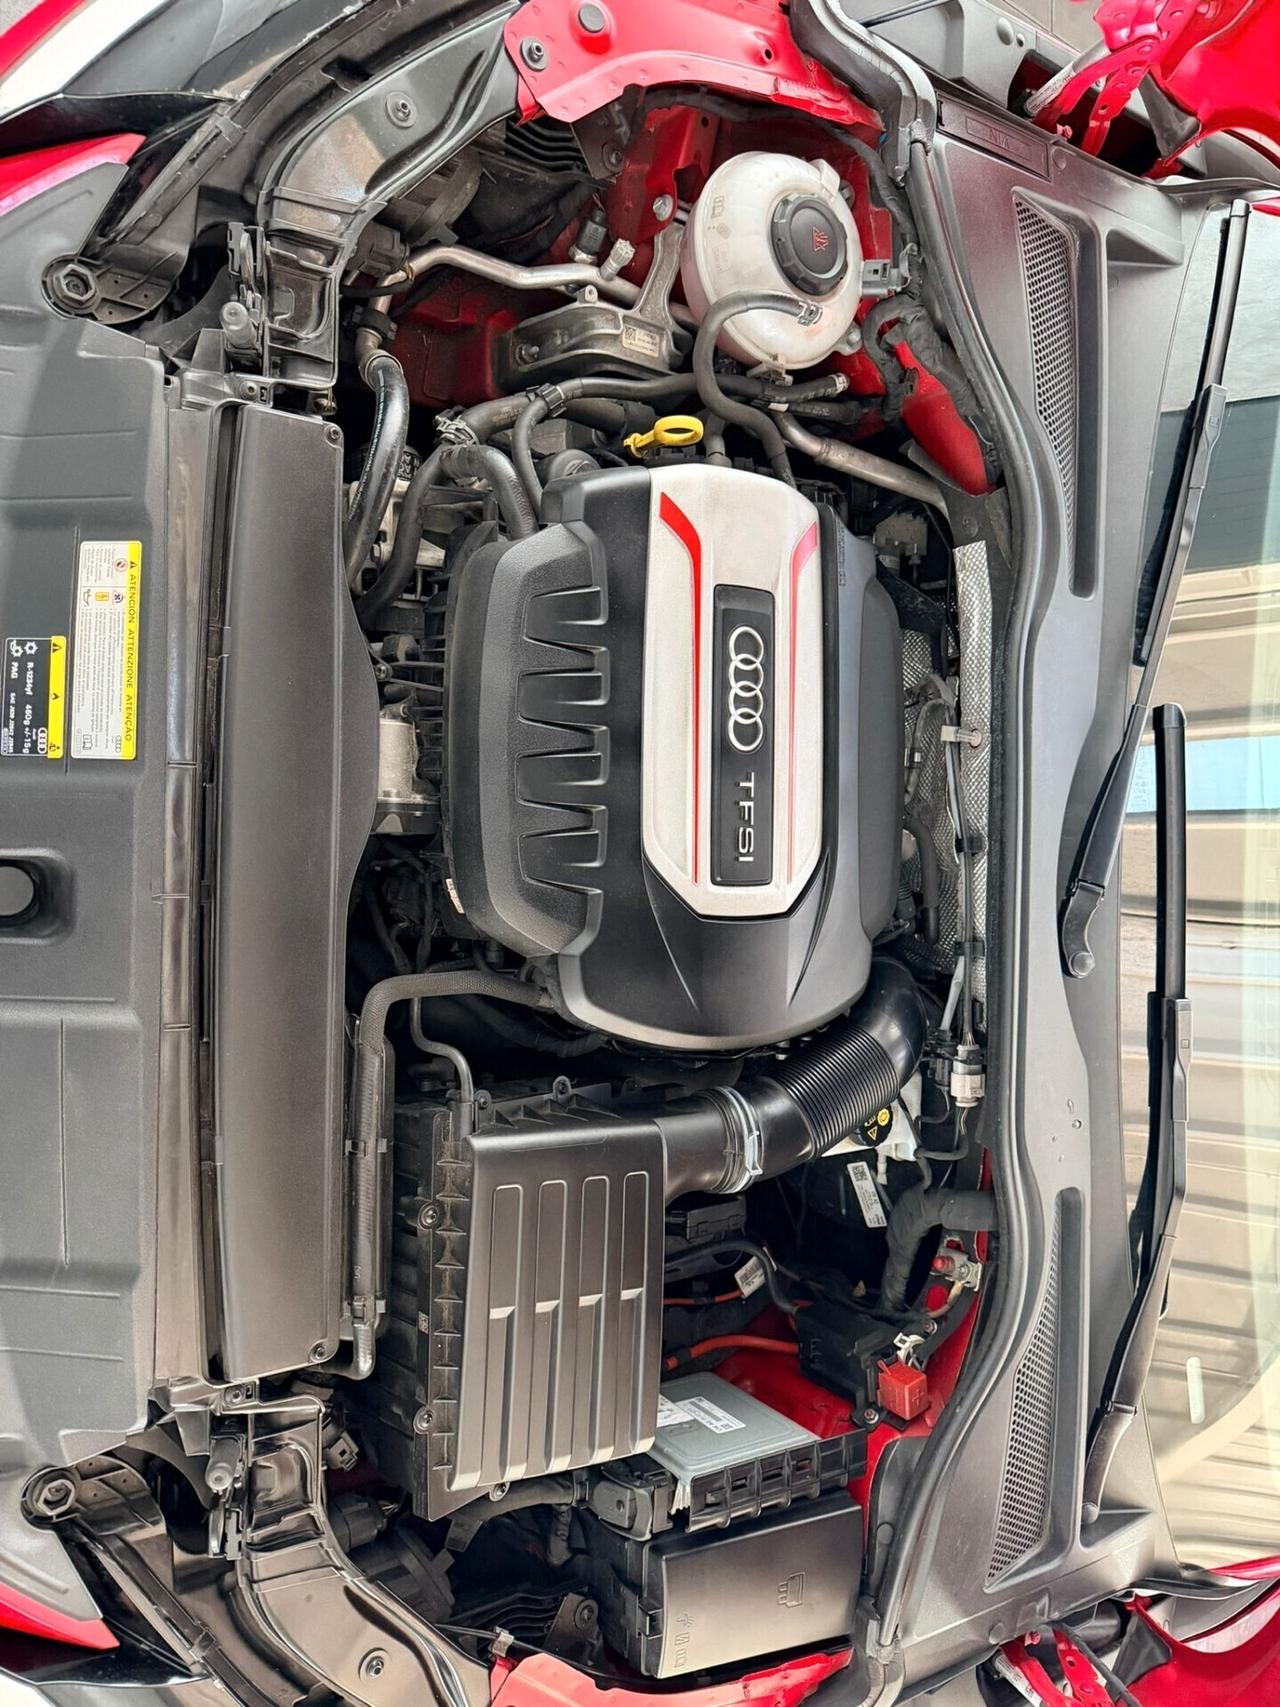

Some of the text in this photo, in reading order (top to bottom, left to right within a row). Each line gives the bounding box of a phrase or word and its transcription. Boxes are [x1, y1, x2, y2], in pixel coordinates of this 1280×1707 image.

[11, 661, 19, 679] PAG
[126, 628, 135, 689] ATTENZIONE
[737, 771, 755, 862] TFSI
